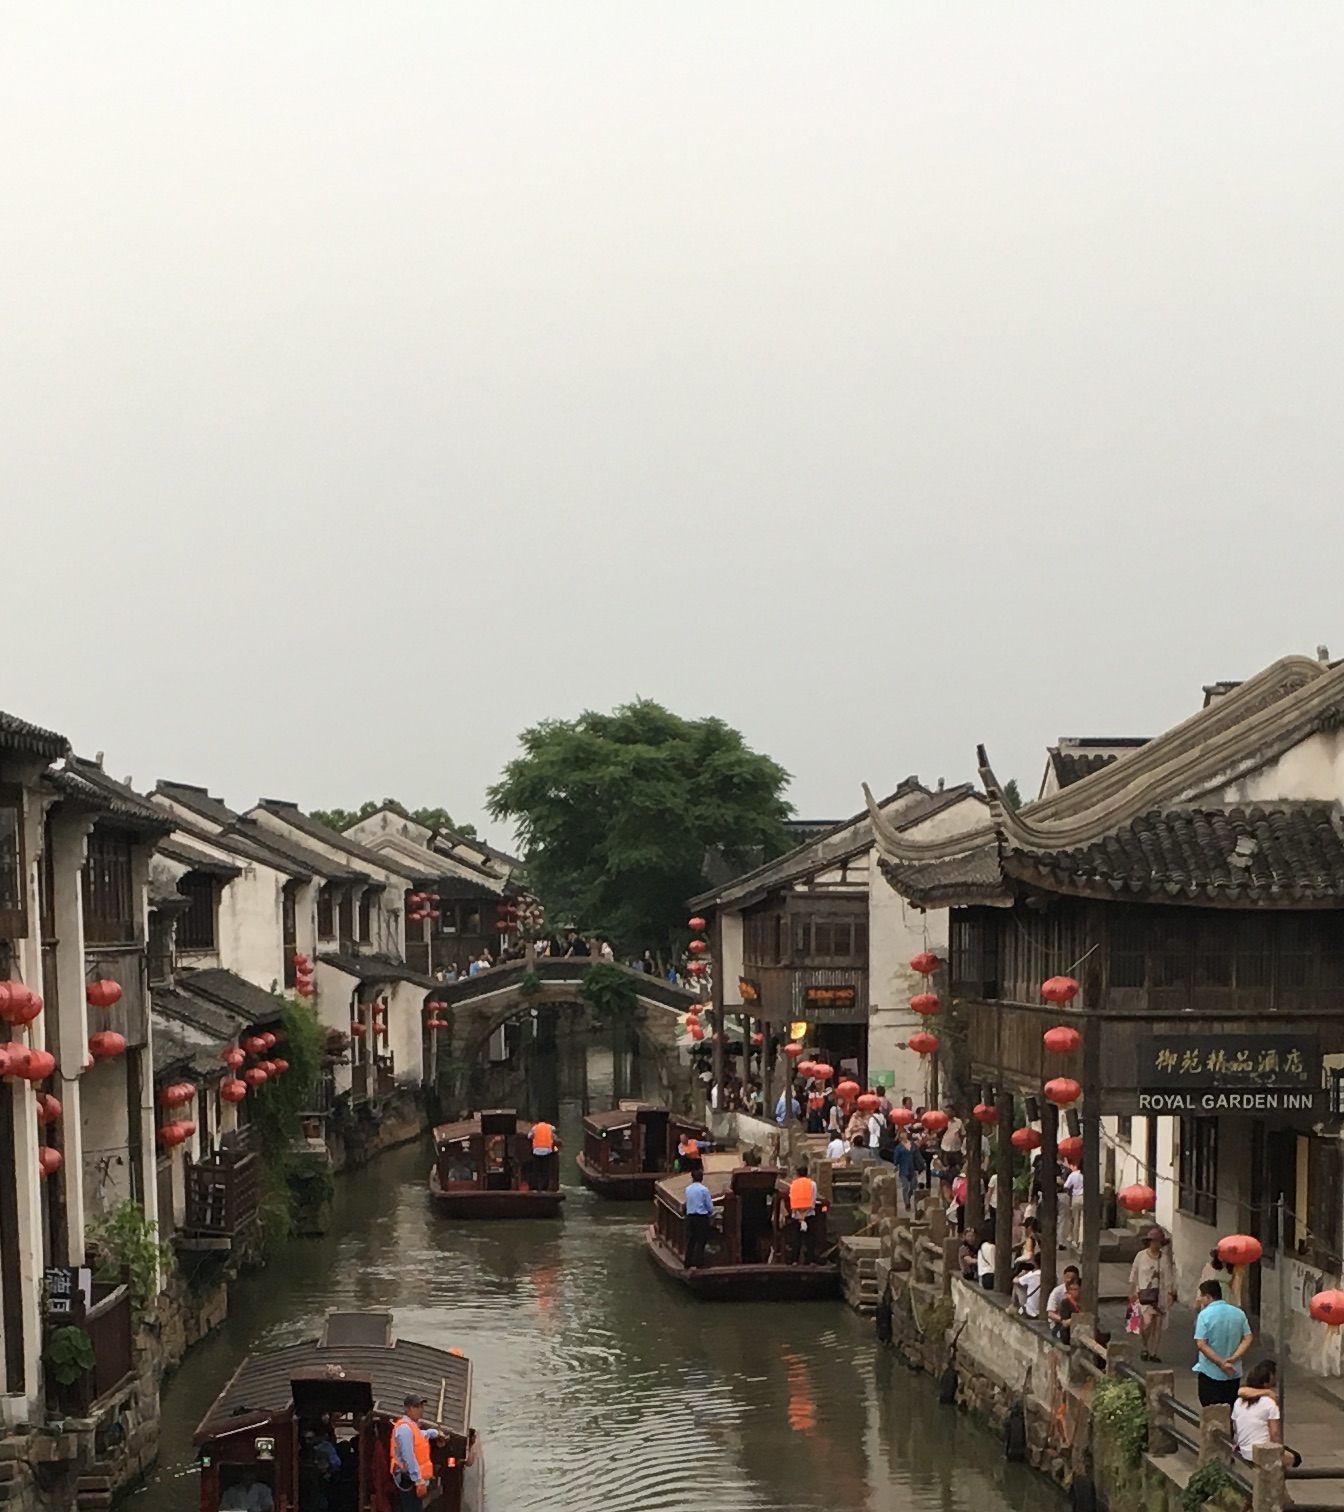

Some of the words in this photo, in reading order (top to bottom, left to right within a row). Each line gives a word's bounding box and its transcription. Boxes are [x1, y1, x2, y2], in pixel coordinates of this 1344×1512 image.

[1139, 1094, 1196, 1110] ROYAL
[1202, 1094, 1278, 1109] GARDEN
[1283, 1094, 1313, 1109] INN
